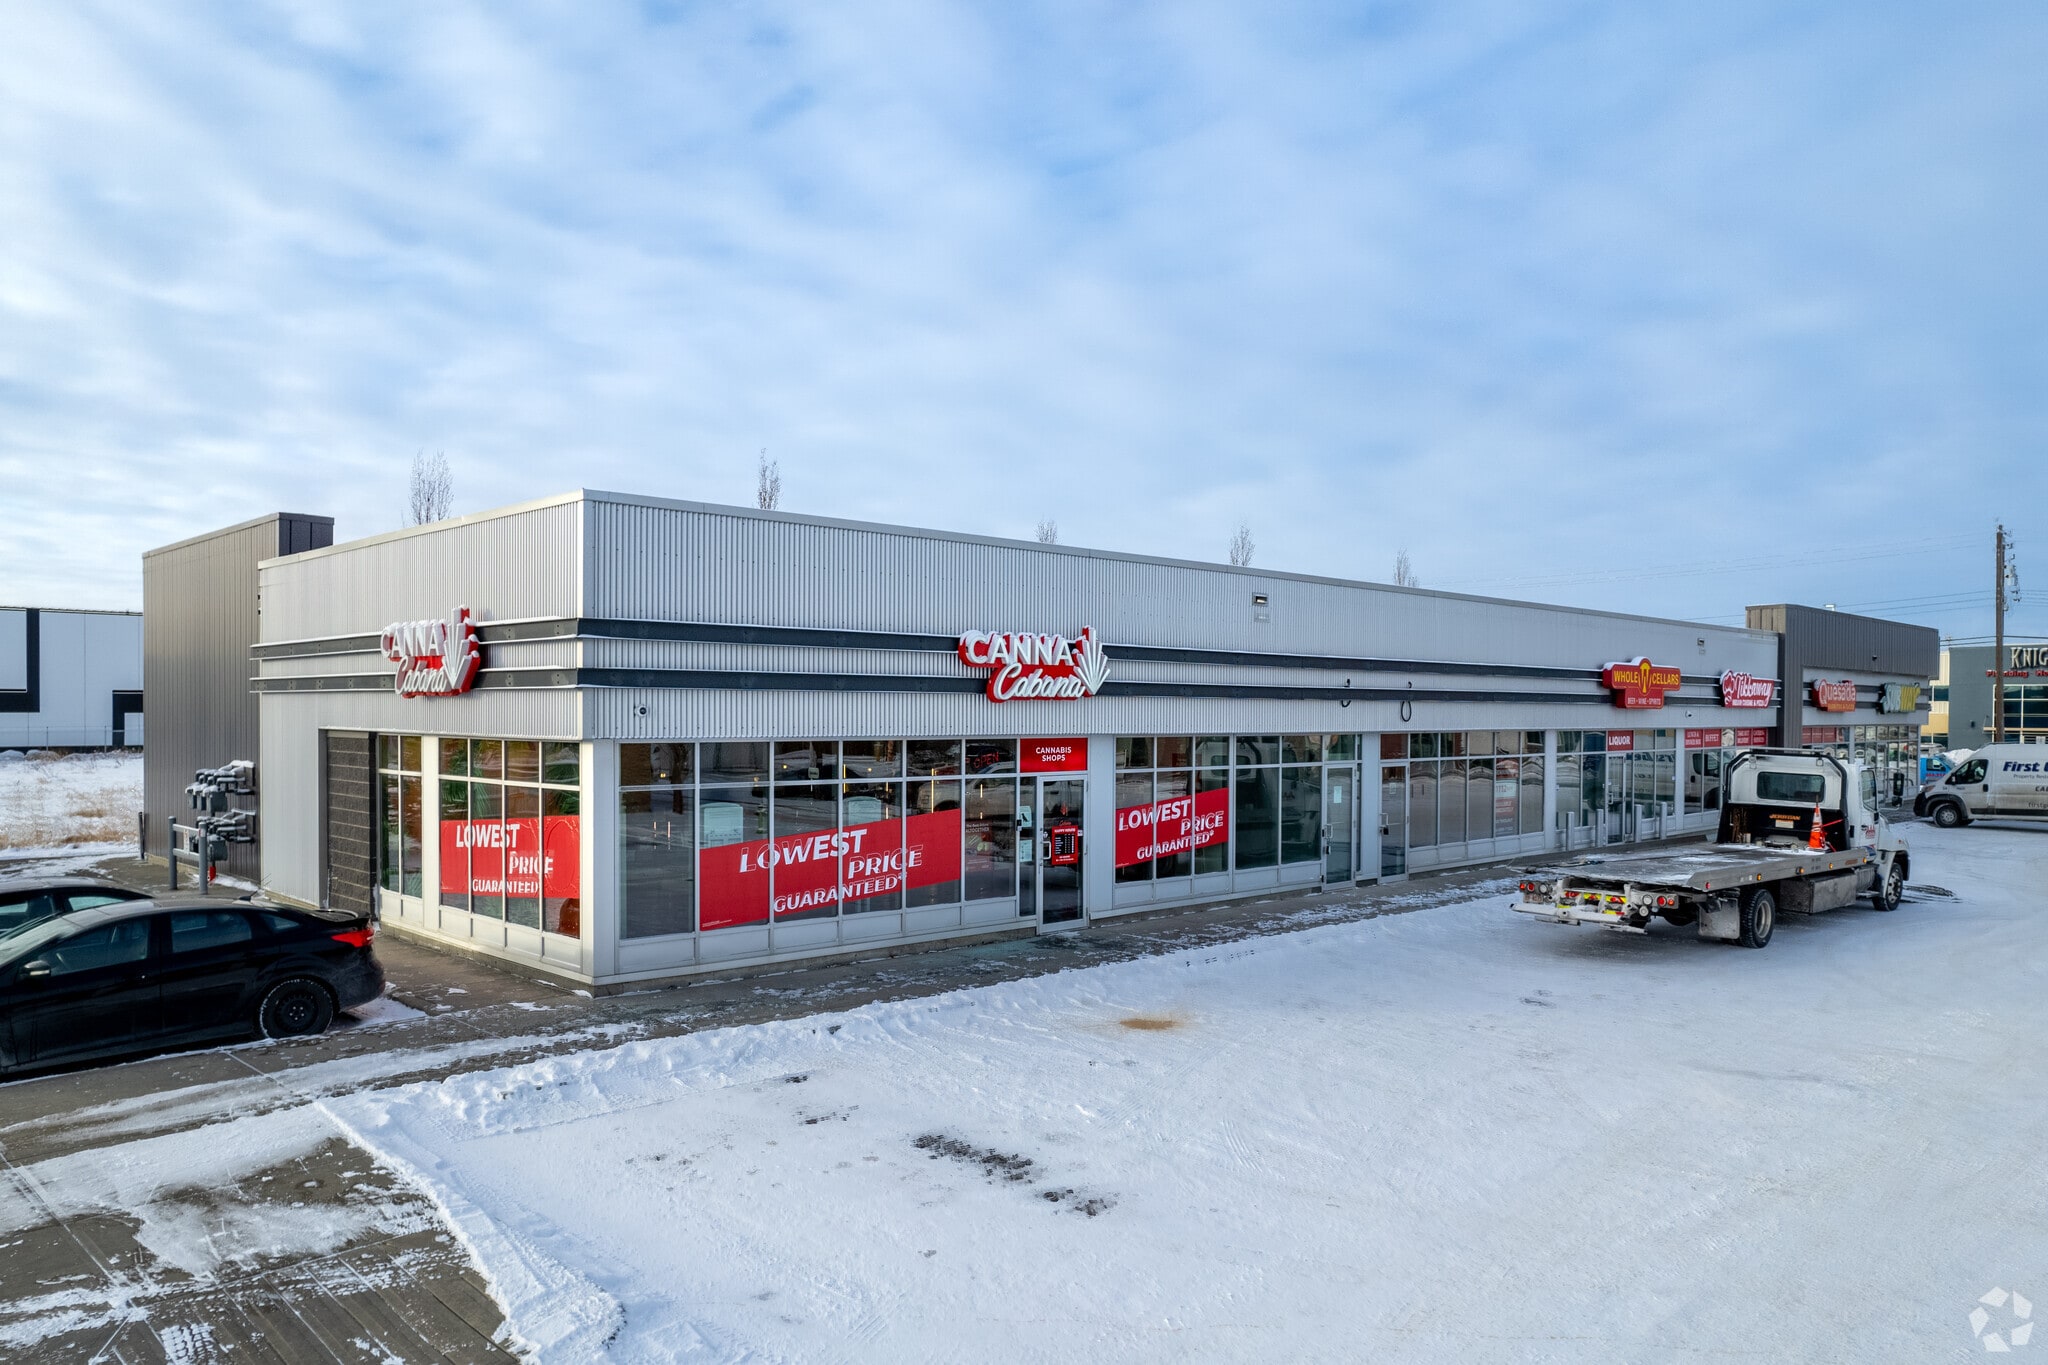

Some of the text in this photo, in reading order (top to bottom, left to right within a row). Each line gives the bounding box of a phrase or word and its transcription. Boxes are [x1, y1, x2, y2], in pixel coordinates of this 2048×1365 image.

[381, 622, 446, 658] CANNA
[967, 633, 1075, 666] CANNA
[395, 656, 448, 694] Cabana
[993, 662, 1086, 700] Cabana
[1613, 670, 1679, 685] WHOLE CELLARS
[1819, 680, 1857, 704] Quesada
[1035, 746, 1072, 754] CANNABIS
[1608, 735, 1631, 746] LIQUOR
[973, 751, 999, 769] OPEN
[1041, 754, 1066, 762] SHOPS
[2003, 761, 2040, 772] First
[1118, 799, 1192, 832] LOWEST
[1180, 810, 1225, 836] PRICE
[455, 823, 521, 849] LOWEST
[1136, 829, 1215, 860] GUARANTED
[739, 828, 868, 873] LOWEST
[848, 844, 924, 879] PRICE
